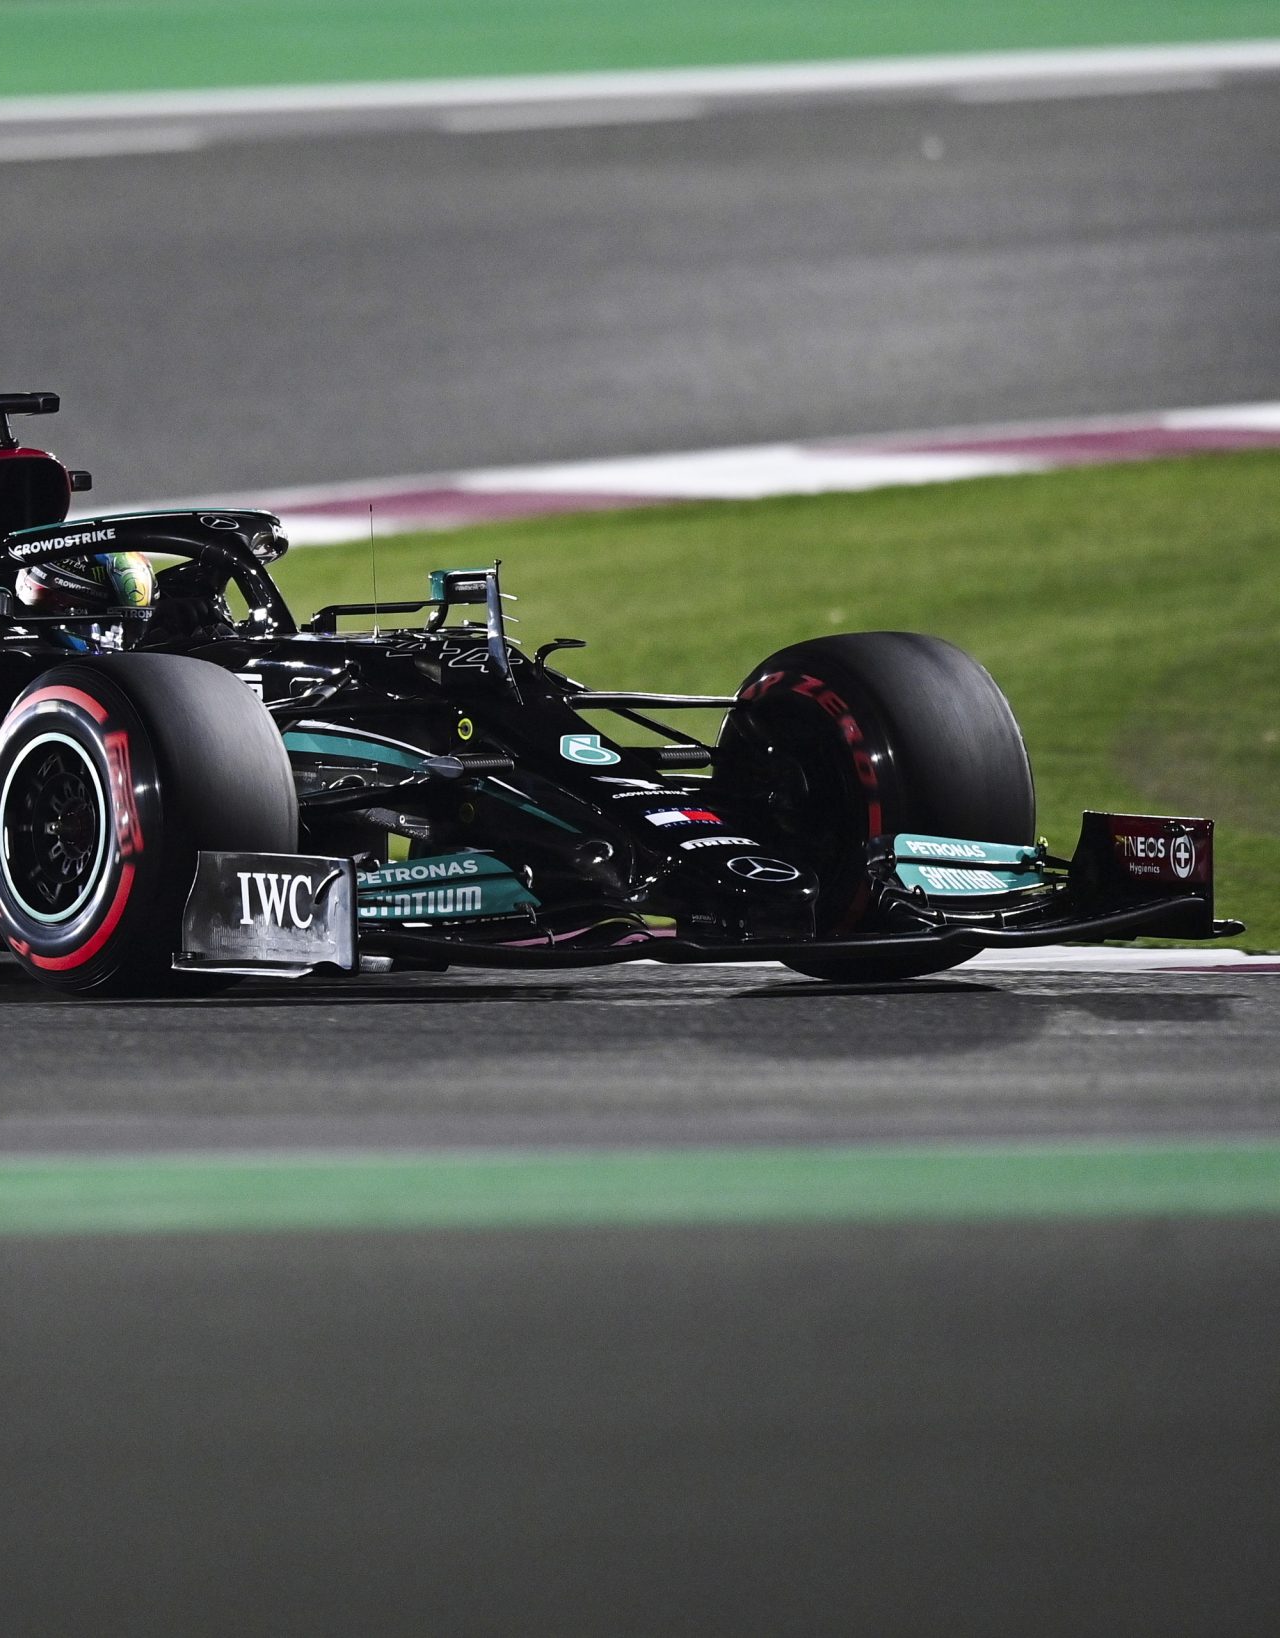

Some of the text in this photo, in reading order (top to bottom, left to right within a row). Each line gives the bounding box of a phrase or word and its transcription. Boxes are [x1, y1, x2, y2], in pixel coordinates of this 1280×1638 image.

[14, 528, 117, 556] CROWDSTRIKE
[906, 841, 986, 858] PETRONAS
[1124, 835, 1166, 858] INEOS
[357, 860, 478, 886] PETRONAS
[1129, 862, 1160, 874] Hygienics
[237, 872, 313, 929] IWC
